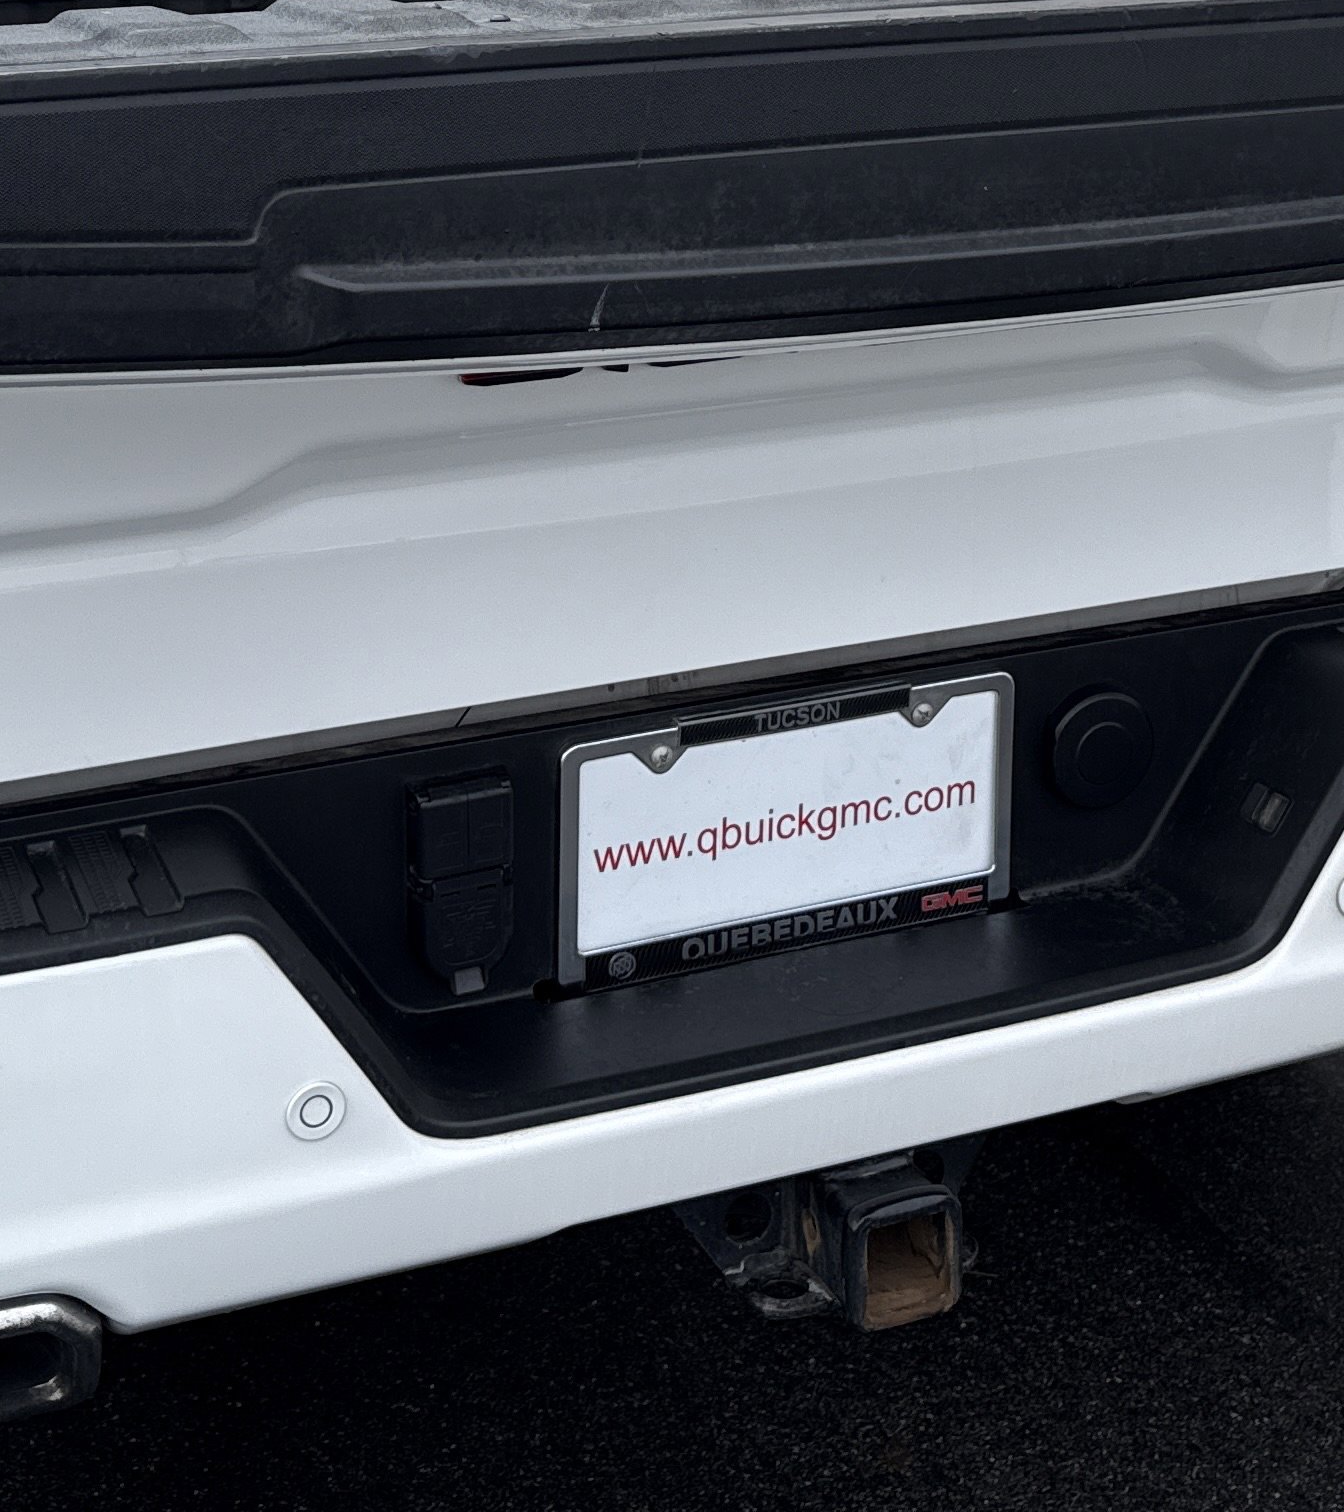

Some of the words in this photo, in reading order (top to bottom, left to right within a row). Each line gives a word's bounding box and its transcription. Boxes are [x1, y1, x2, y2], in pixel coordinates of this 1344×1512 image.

[755, 701, 840, 734] TUCSON
[593, 780, 976, 873] www.qbuickgmc.com
[681, 896, 899, 961] QUEBEDEAUX
[921, 885, 984, 913] GMC
